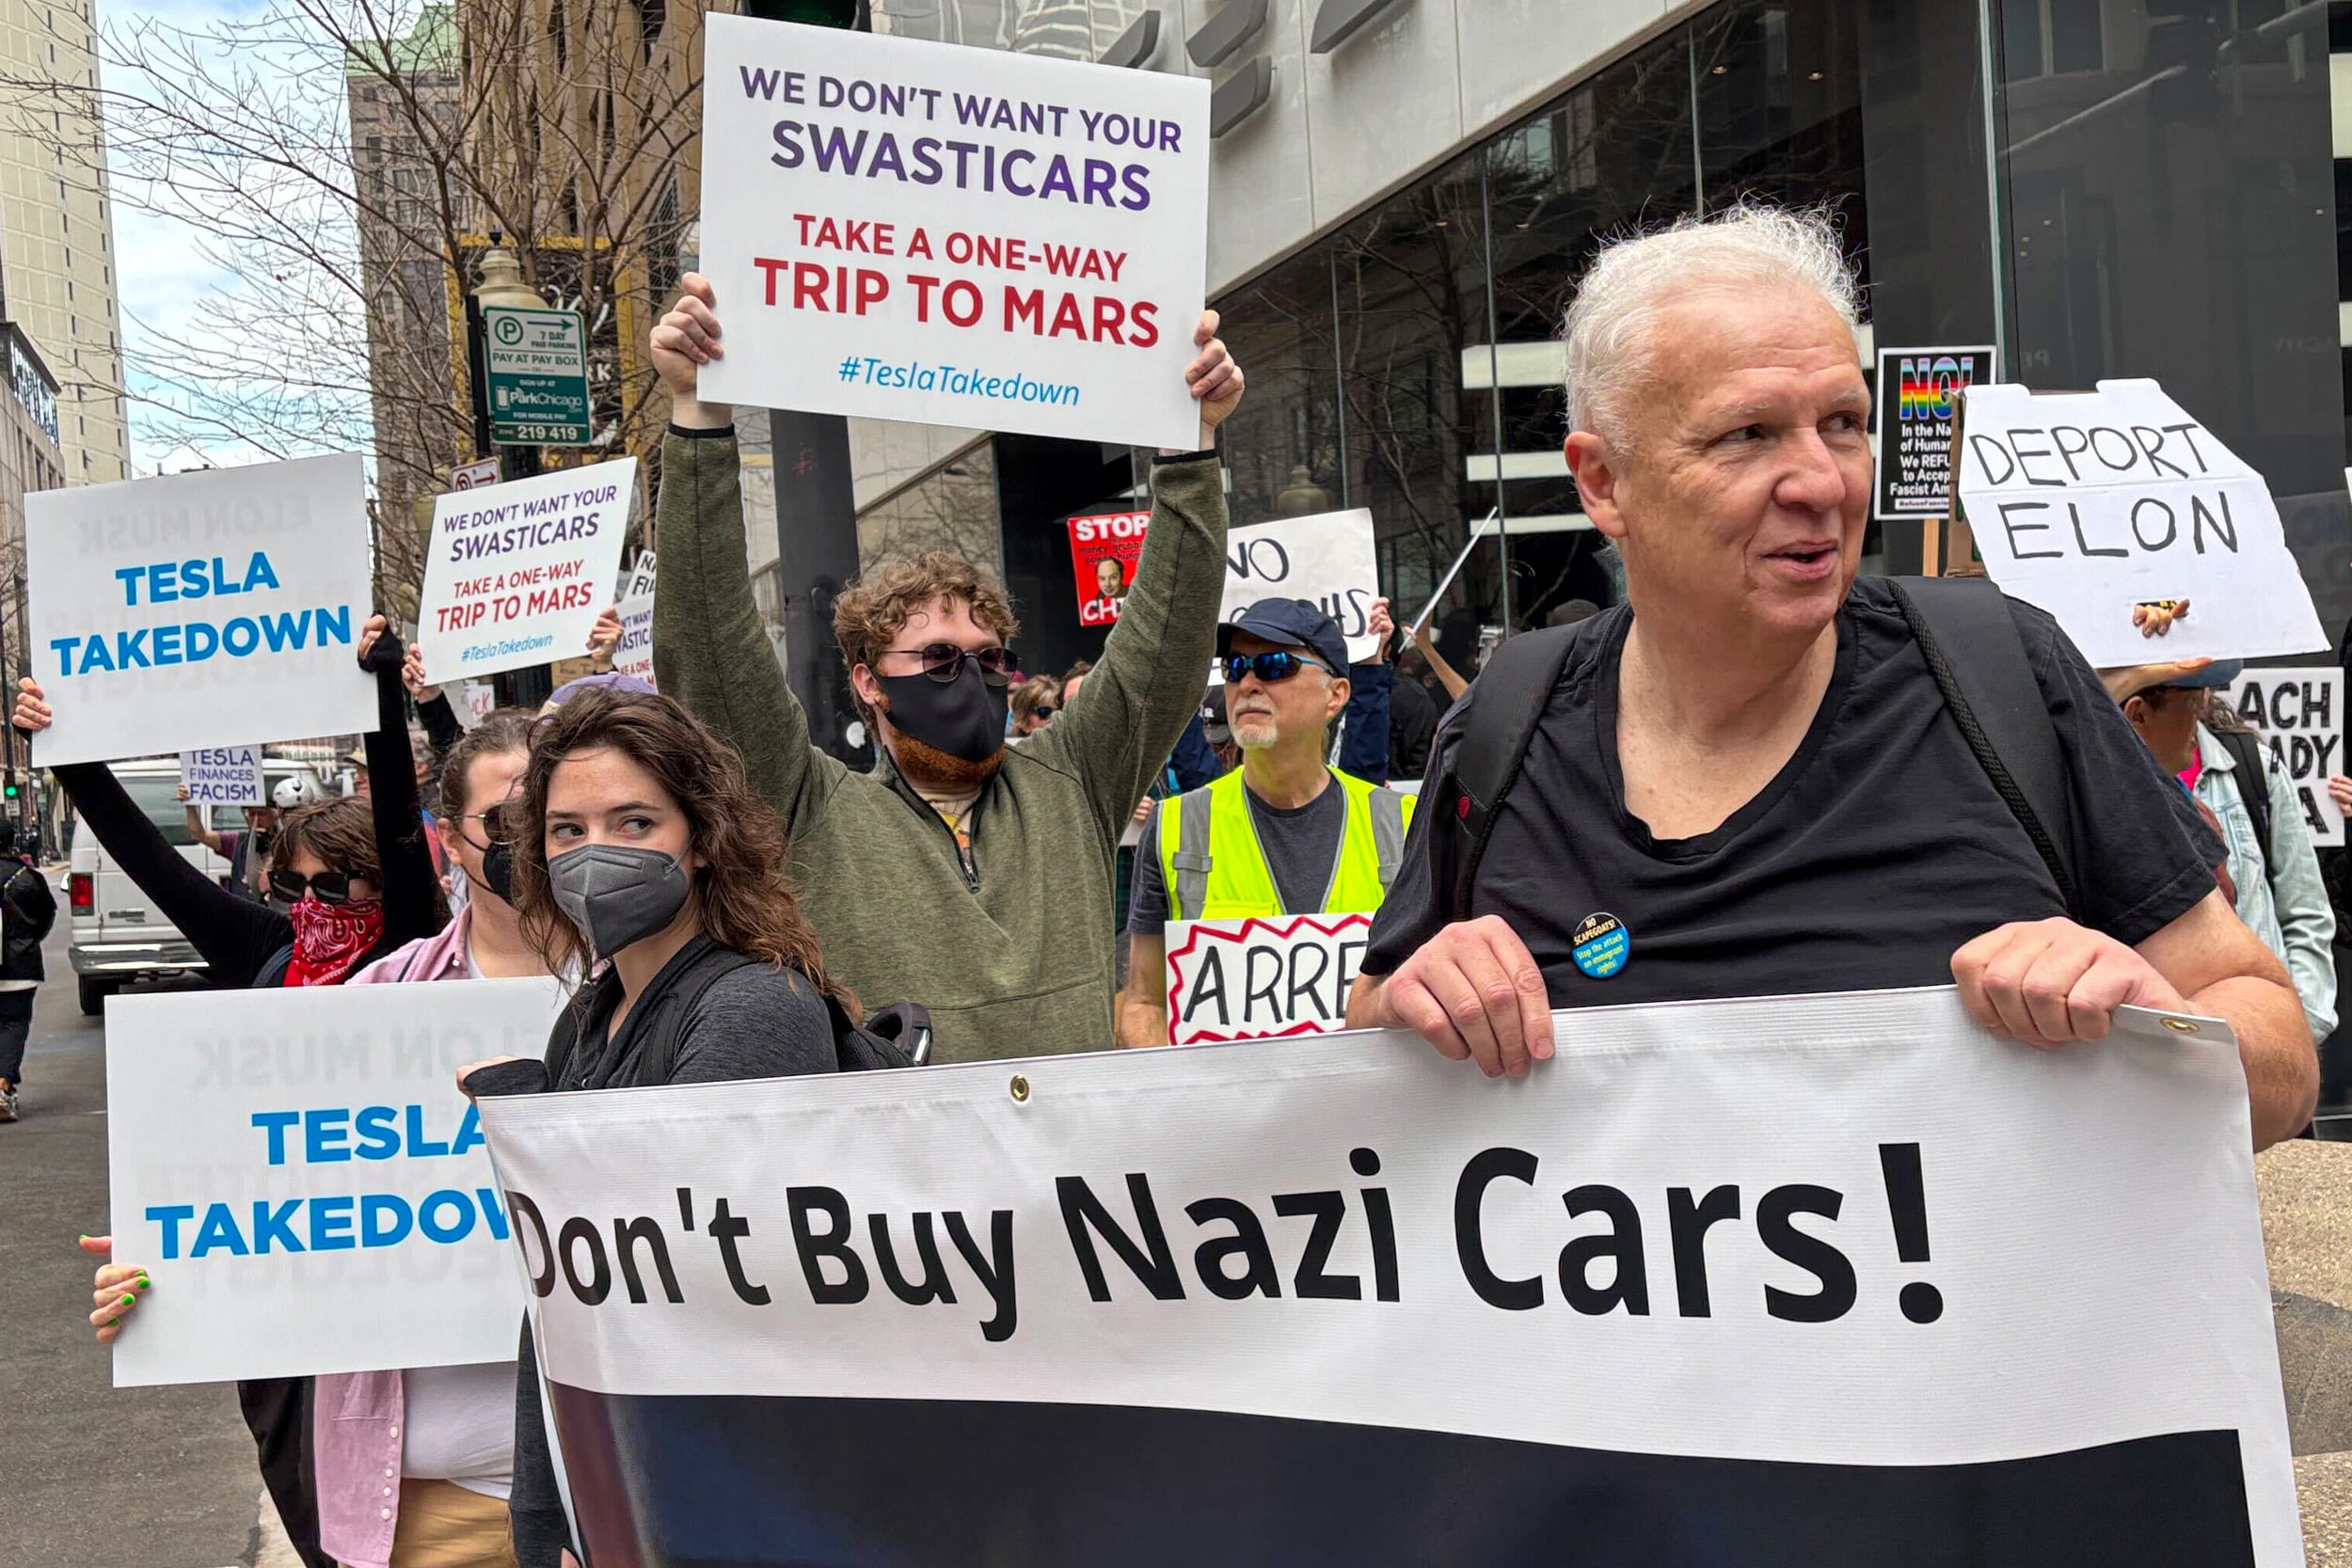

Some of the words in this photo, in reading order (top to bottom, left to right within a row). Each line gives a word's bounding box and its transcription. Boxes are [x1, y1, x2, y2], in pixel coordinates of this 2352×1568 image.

[739, 65, 805, 104] WE
[818, 75, 941, 120] DON'T
[953, 93, 1069, 137] WANT
[1080, 109, 1182, 152] YOUR
[771, 120, 1151, 212] SWASTICARS
[793, 214, 895, 255] TAKE
[906, 228, 933, 260] A
[946, 231, 1127, 282] ONE-WAY
[754, 258, 889, 316] TRIP
[906, 276, 983, 327] TO
[1004, 286, 1159, 348] MARS
[539, 331, 546, 340] 7
[549, 331, 566, 341] DAY
[493, 353, 514, 363] PAY
[516, 354, 529, 363] AT
[532, 355, 552, 365] PAY
[555, 356, 579, 366] BOX
[838, 356, 1080, 405] #TeslaTakedown
[510, 388, 582, 408] ParkChicago
[517, 425, 546, 440] 219
[548, 426, 579, 440] 419
[1901, 424, 1913, 437] In
[1915, 423, 1933, 437] the
[1900, 438, 1914, 451] of
[1969, 423, 2209, 486] DEPORT
[1899, 454, 1919, 468] We
[1902, 469, 1915, 482] to
[1890, 483, 1930, 497] Fascist
[444, 517, 468, 532] WE
[471, 505, 518, 528] DON'T
[523, 495, 569, 515] WANT
[575, 485, 616, 507] YOUR
[451, 513, 600, 562] SWASTICARS
[1075, 515, 1150, 541] STOP
[1998, 491, 2238, 559] ELON
[116, 551, 278, 606] TESLA
[454, 577, 490, 598] TAKE
[494, 575, 505, 590] A
[509, 560, 583, 588] ONE-WAY
[437, 602, 485, 632] TRIP
[493, 595, 520, 623] TO
[527, 581, 593, 616] MARS
[51, 606, 351, 676] TAKEDOWN
[461, 634, 553, 661] #TeslaTakedown
[191, 749, 254, 766] TESLA
[190, 768, 255, 781] FINANCES
[190, 784, 257, 800] FACISM
[1585, 917, 1597, 929] NO
[1577, 949, 1592, 959] Stop
[1592, 943, 1602, 953] the
[504, 1187, 771, 1307] Don't
[786, 1186, 1018, 1343] Buy
[1056, 1148, 1400, 1305] Nazi
[1453, 1143, 1946, 1324] Cars!
